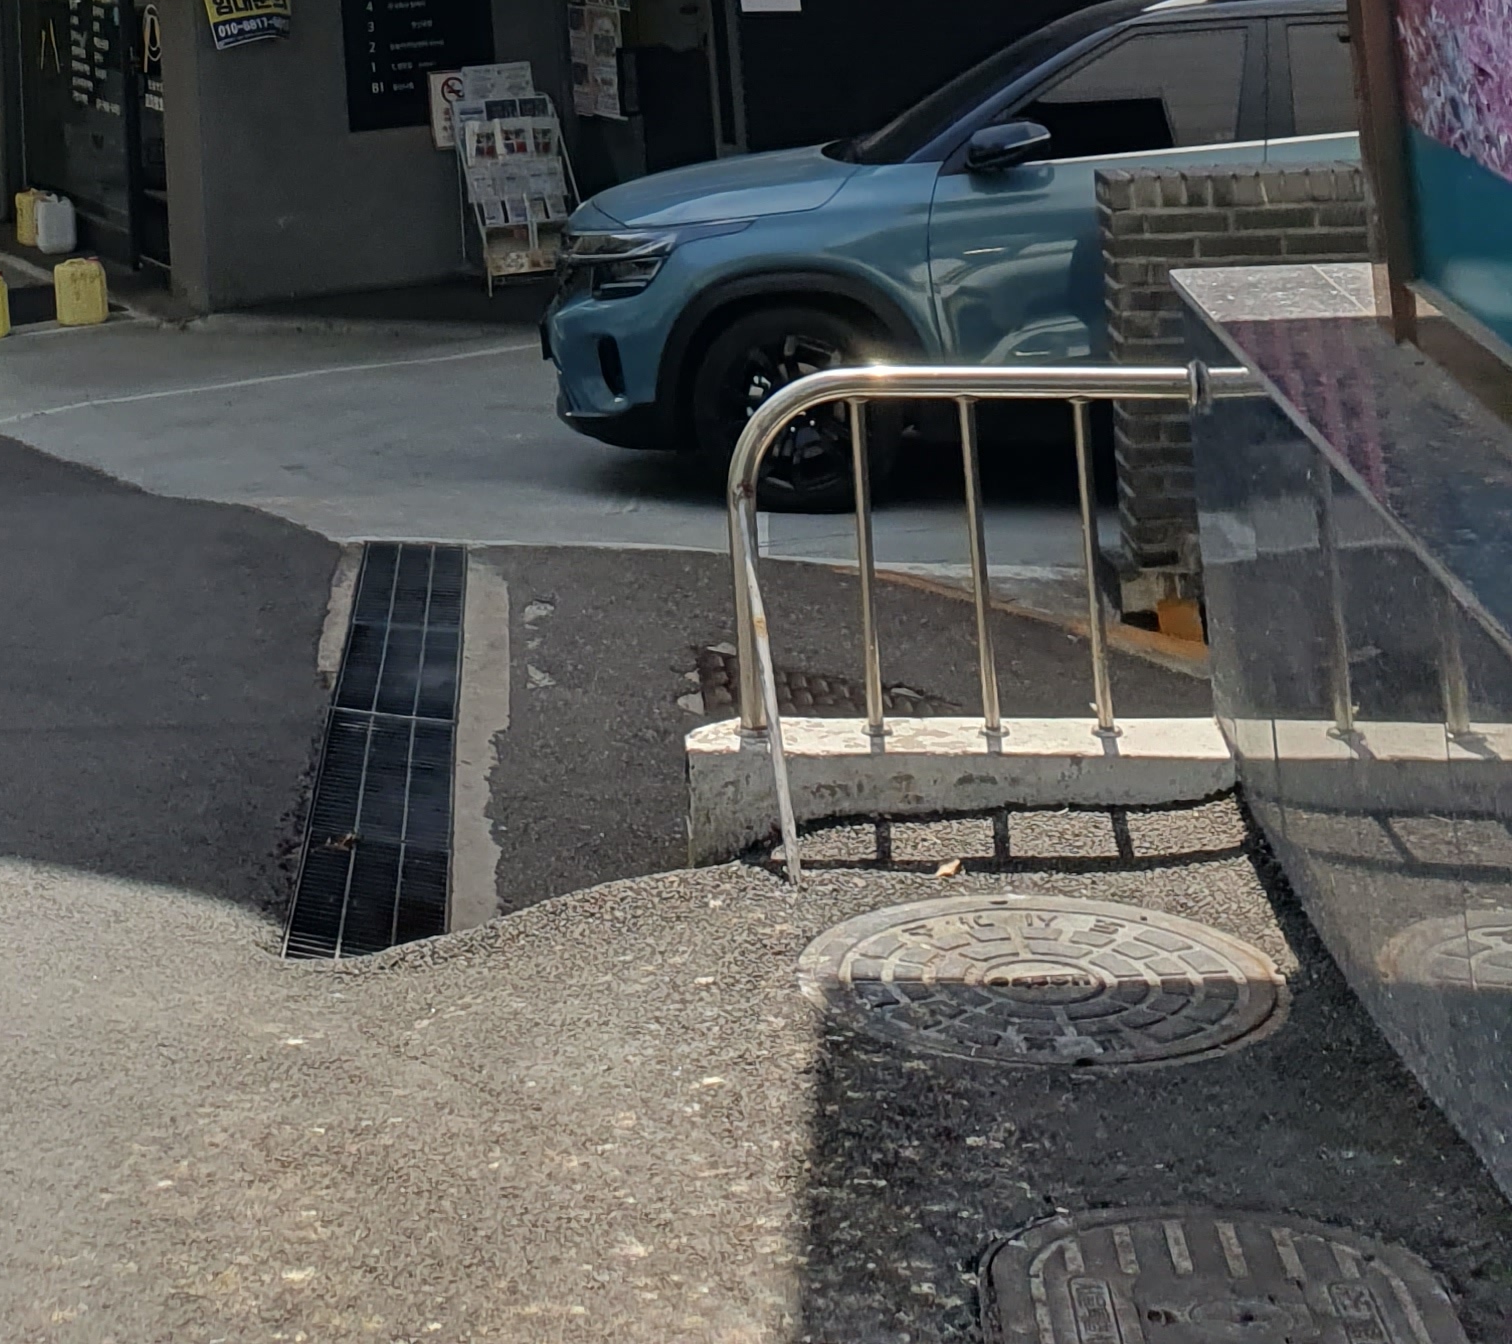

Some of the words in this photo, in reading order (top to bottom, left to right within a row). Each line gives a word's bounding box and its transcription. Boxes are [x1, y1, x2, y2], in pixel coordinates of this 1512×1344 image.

[365, 0, 374, 12] 4
[368, 21, 375, 33] 3
[369, 41, 376, 53] 2
